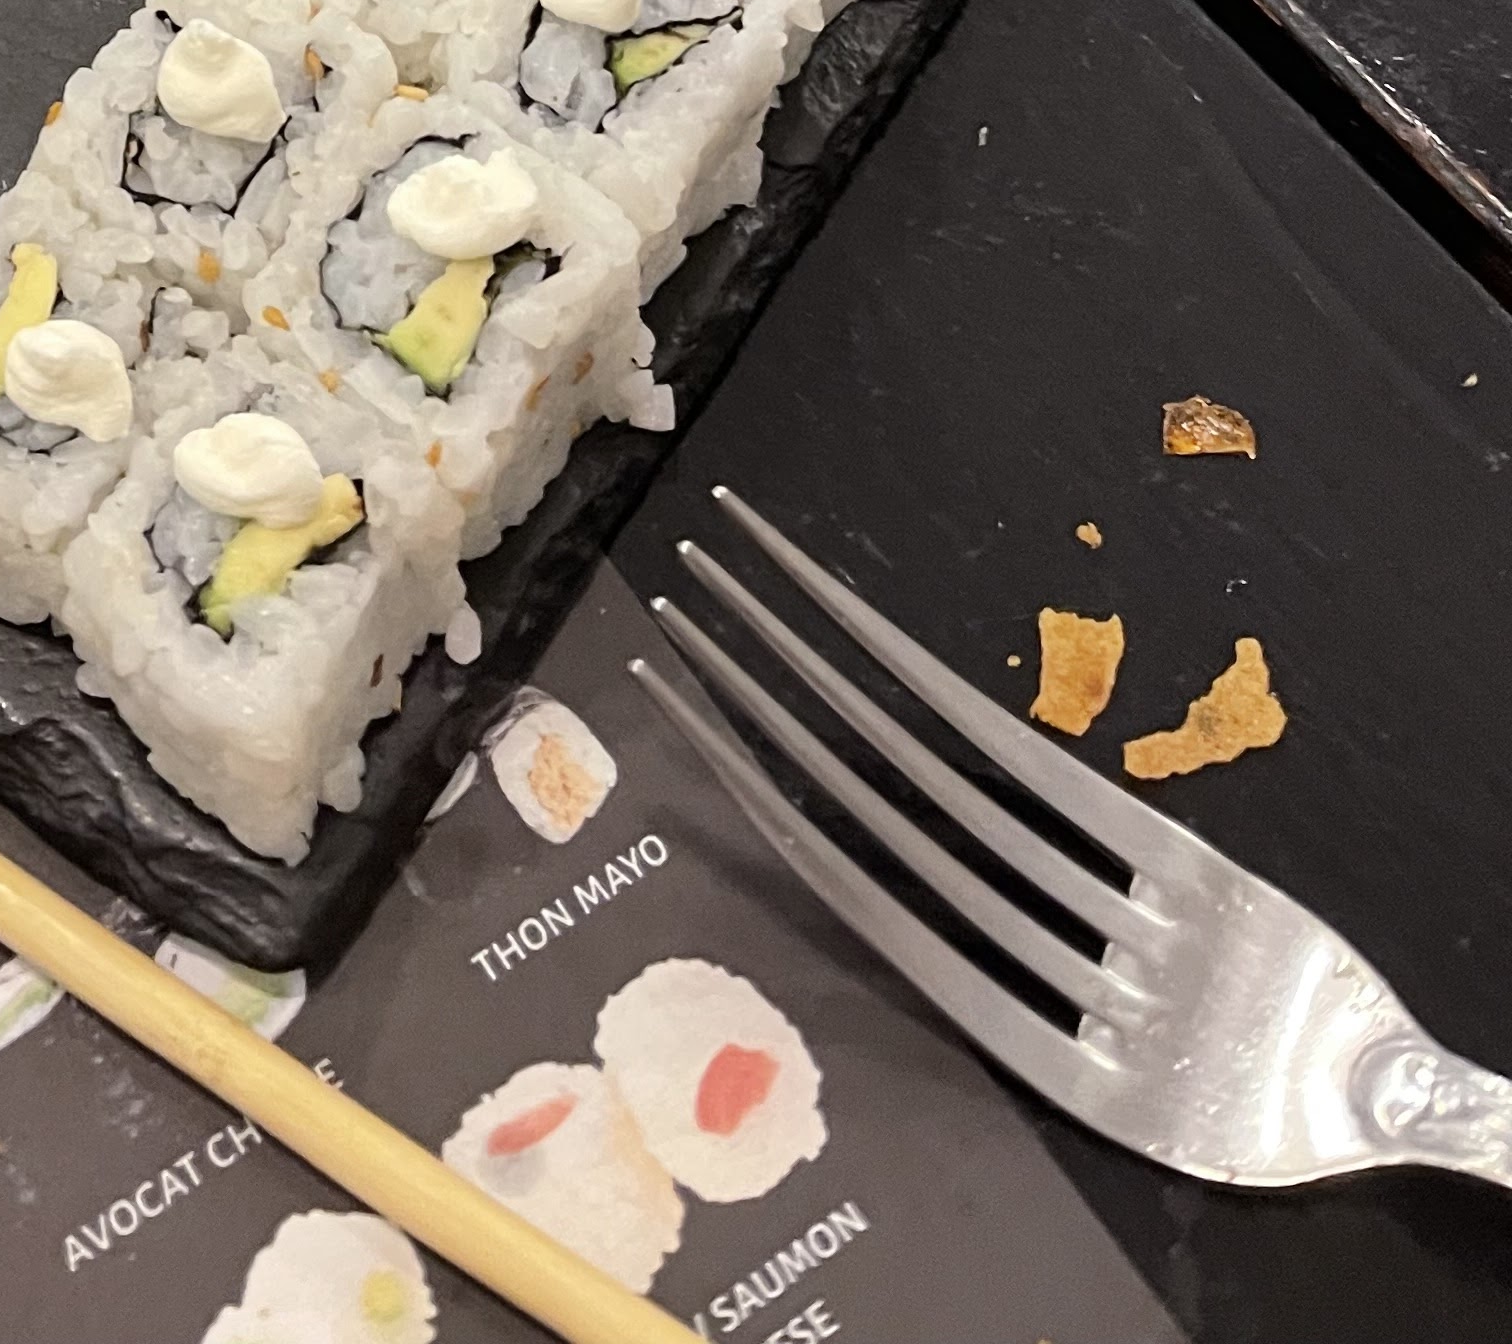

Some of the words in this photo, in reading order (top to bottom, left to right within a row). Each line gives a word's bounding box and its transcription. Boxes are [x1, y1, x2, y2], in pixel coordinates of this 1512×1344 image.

[469, 904, 574, 984] THON
[573, 833, 672, 919] MAYO
[63, 1150, 204, 1273] AVOCAT
[708, 1200, 872, 1334] SAUMON
